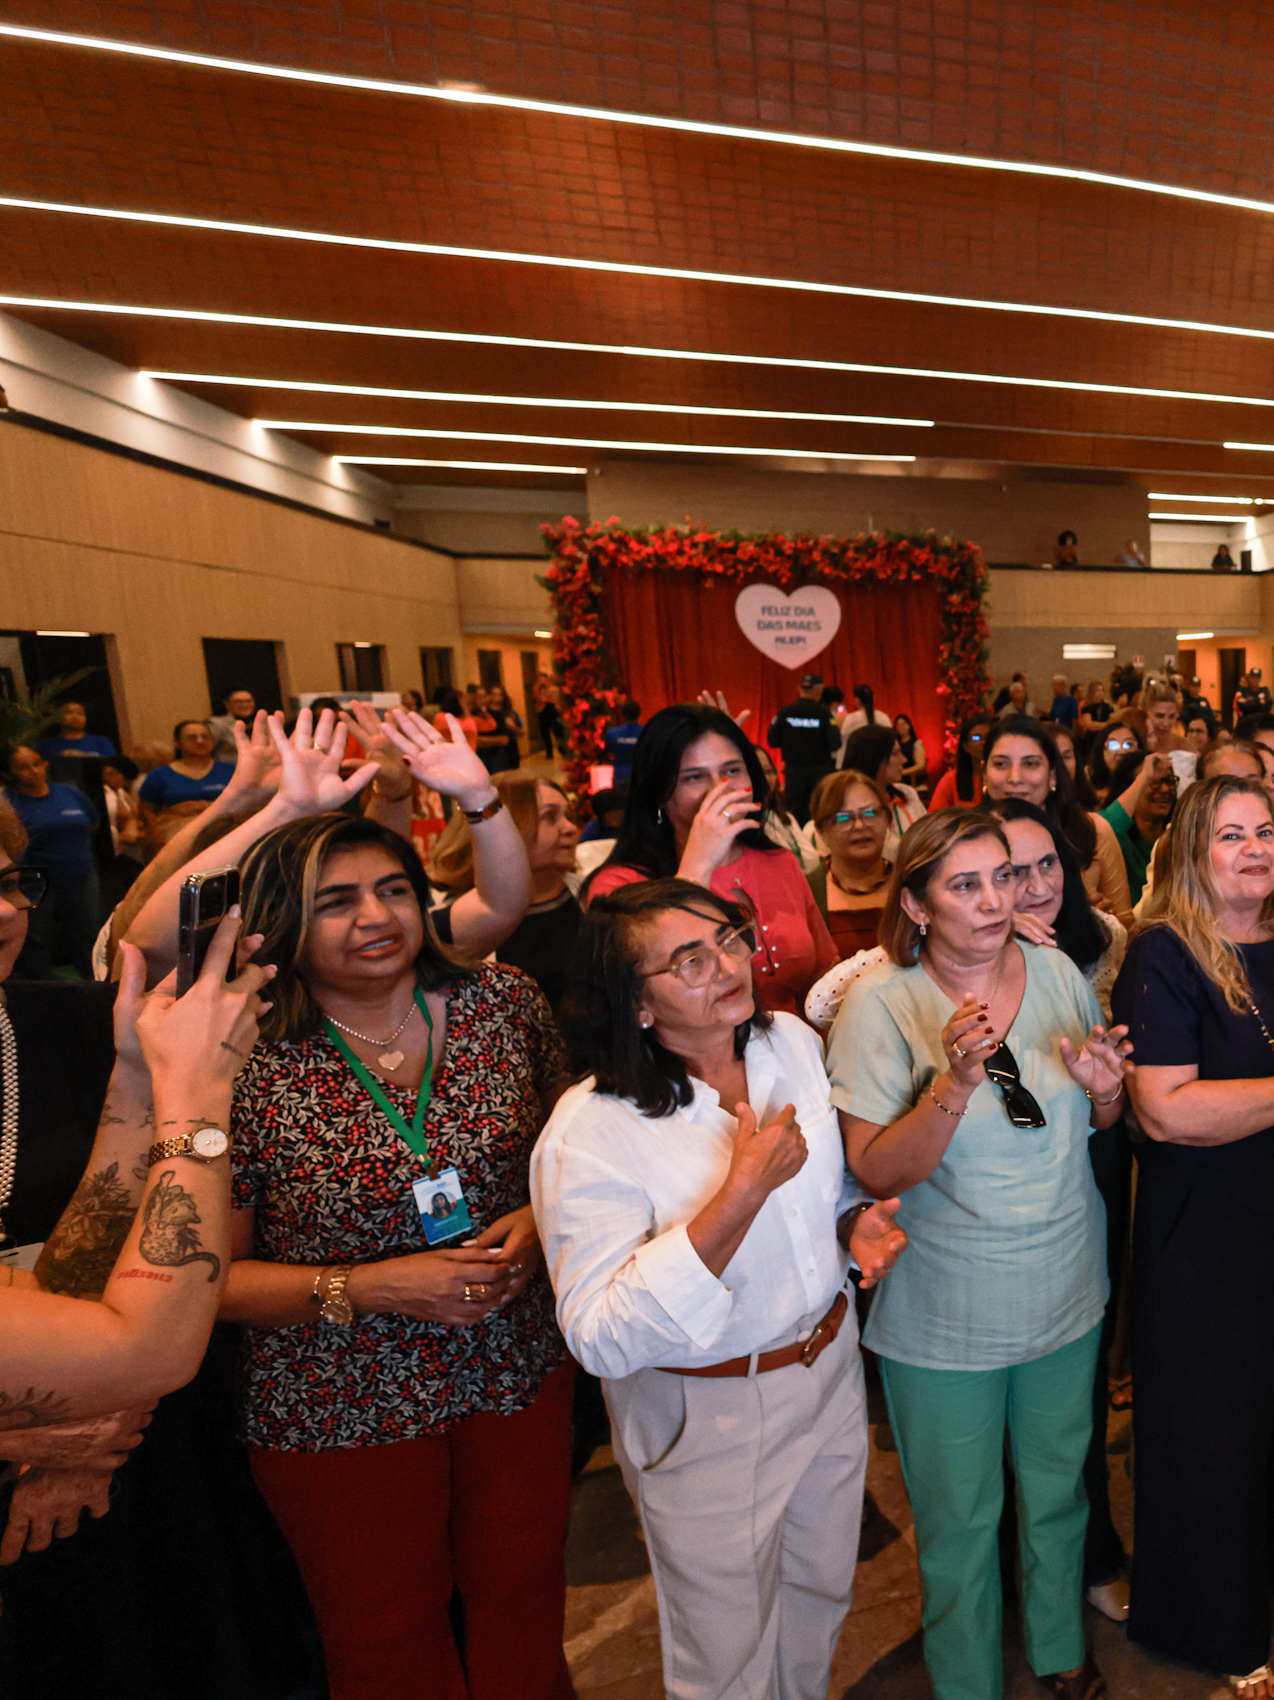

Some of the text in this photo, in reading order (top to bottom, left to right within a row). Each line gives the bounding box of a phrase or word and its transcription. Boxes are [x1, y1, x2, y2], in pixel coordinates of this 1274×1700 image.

[761, 606, 815, 617] FELIZ DIA
[757, 620, 784, 632] DAS
